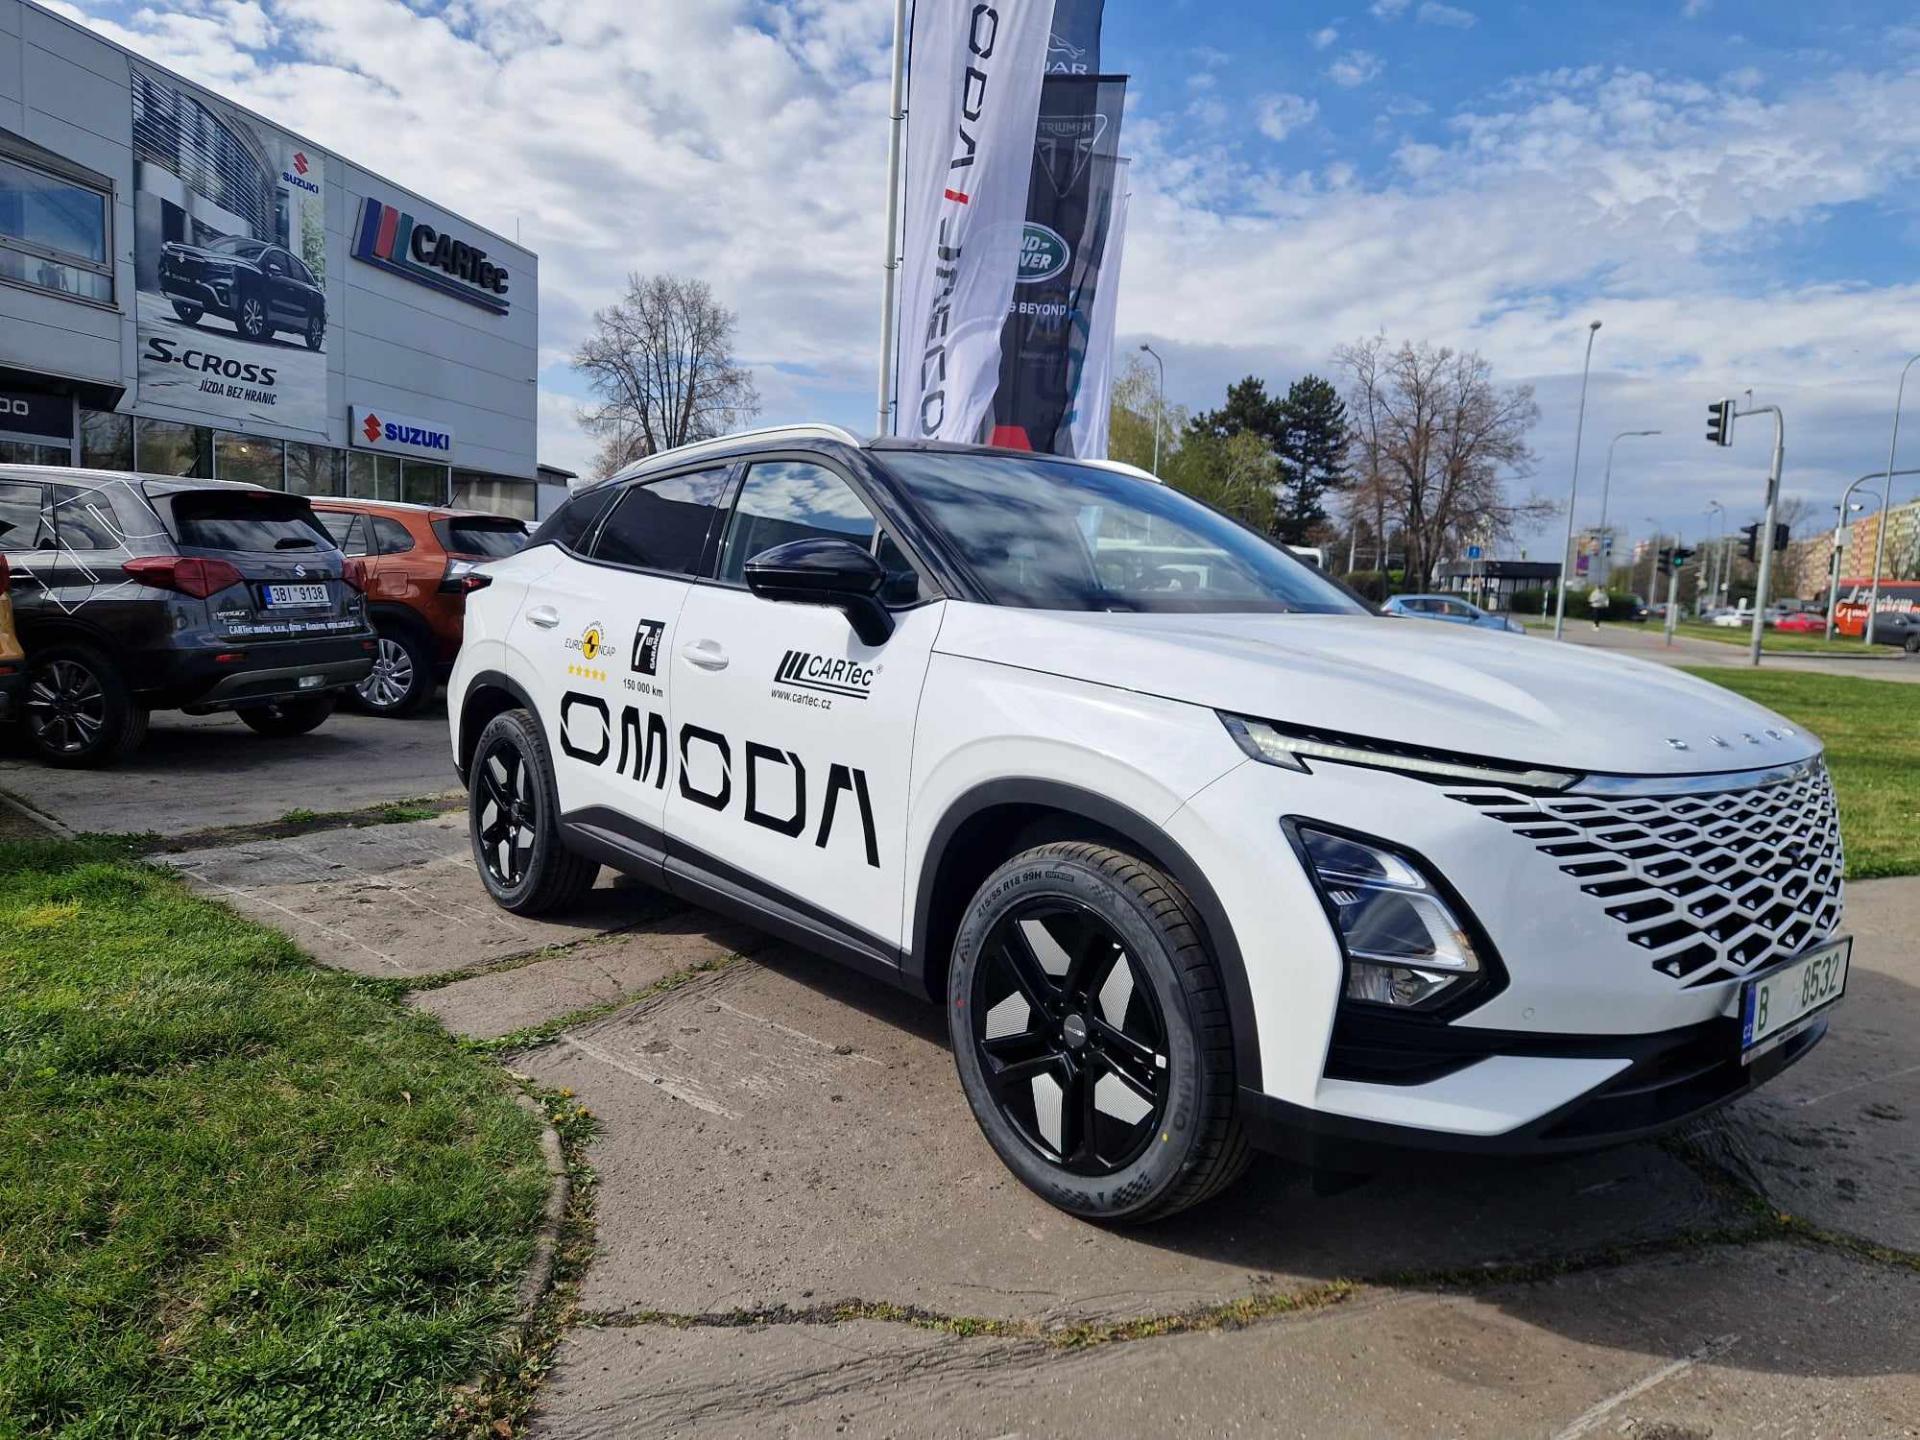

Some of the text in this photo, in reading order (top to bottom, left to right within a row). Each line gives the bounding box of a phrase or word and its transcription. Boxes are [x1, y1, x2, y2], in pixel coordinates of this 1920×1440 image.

[282, 171, 319, 194] SUZUKI
[411, 224, 509, 294] CARTec
[1019, 302, 1067, 316] BEYOND
[143, 337, 277, 386] S-CROSS
[198, 377, 277, 406] JÍZDA BEZ HRANIC
[384, 422, 450, 451] SUZUKI
[299, 586, 325, 601] 9138
[564, 637, 616, 657] EURO NCAP
[634, 624, 651, 667] 7
[623, 678, 664, 697] 150 000 km
[771, 688, 832, 710] www.cartec.cz
[560, 690, 881, 868] OMODA
[1022, 870, 1042, 882] 99H
[1757, 952, 1840, 1032] B 8532
